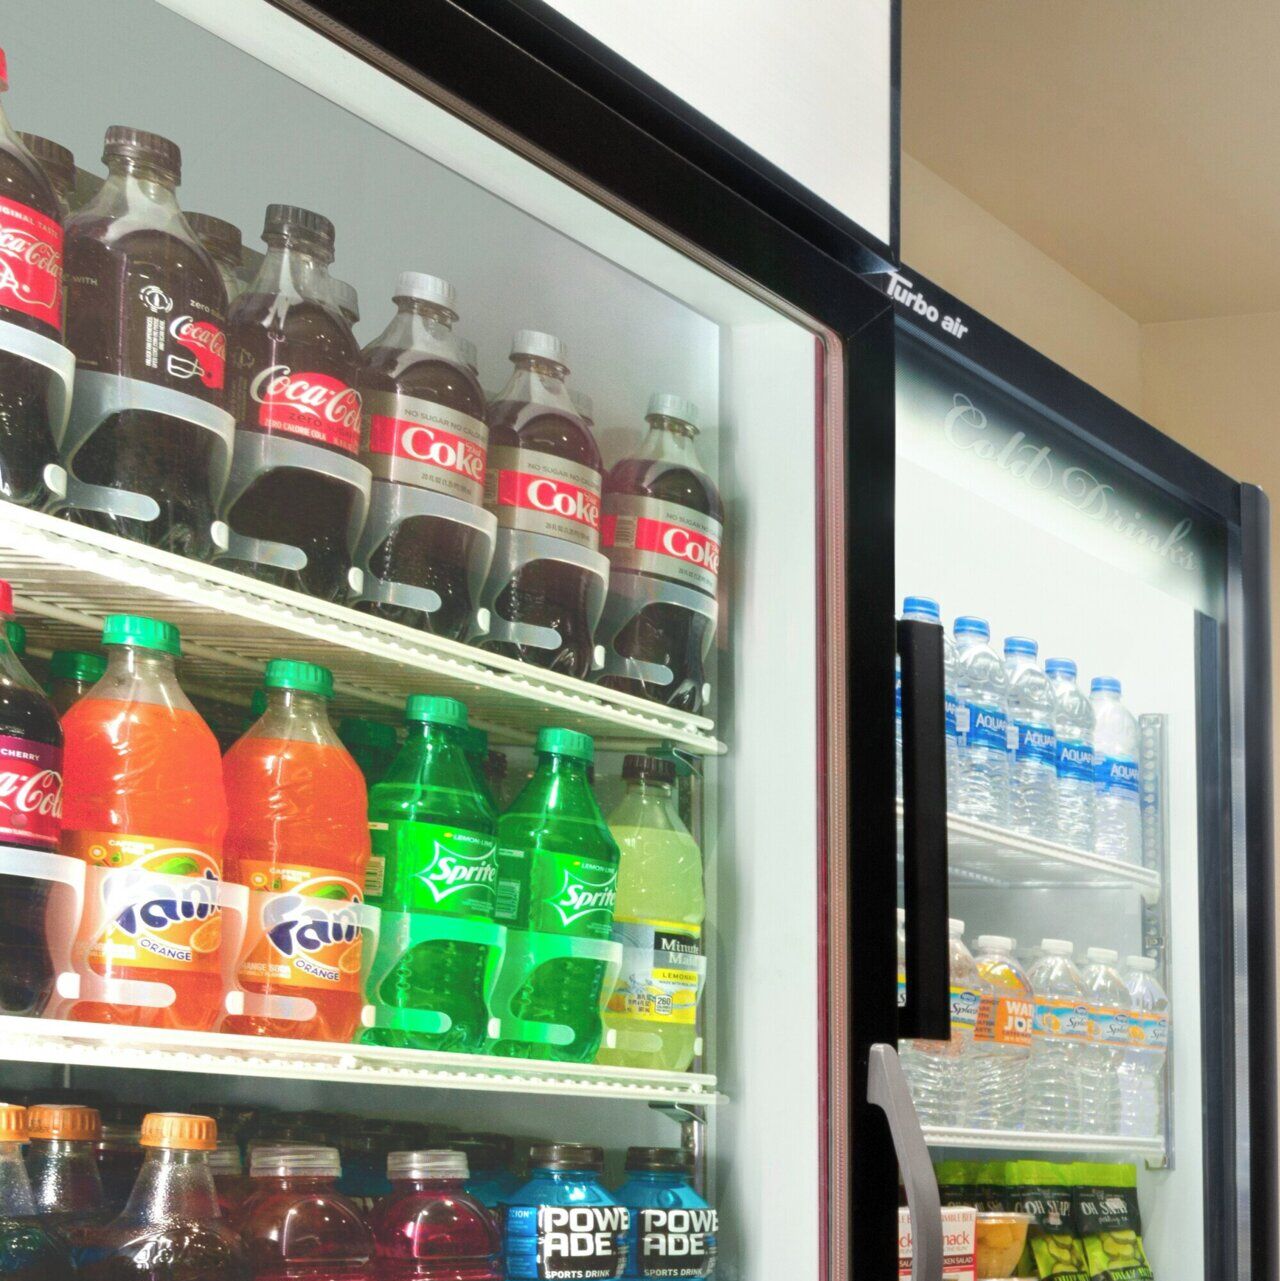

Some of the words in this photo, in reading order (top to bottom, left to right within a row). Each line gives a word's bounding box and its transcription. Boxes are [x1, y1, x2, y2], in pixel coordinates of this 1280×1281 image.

[887, 270, 940, 323] Turbo
[941, 315, 969, 340] air
[404, 408, 418, 418] NO
[420, 411, 449, 426] SUGAR
[401, 426, 484, 480] Coke
[943, 392, 1054, 491] Cold
[1058, 466, 1198, 566] Drinks
[527, 479, 600, 527] Coke
[663, 527, 719, 574] Coke
[430, 857, 496, 884] Sprite
[140, 937, 192, 961] ORANGE
[295, 959, 340, 982] ORANGE
[1004, 1016, 1033, 1033] JOE
[1081, 1201, 1099, 1216] OH
[544, 1233, 613, 1258] ADE
[643, 1234, 705, 1257] ADE
[955, 1255, 975, 1266] SALAD
[545, 1270, 583, 1280] SPORTS
[586, 1269, 610, 1279] DRINK
[643, 1268, 678, 1278] SPORTS
[680, 1267, 703, 1277] DRINK
